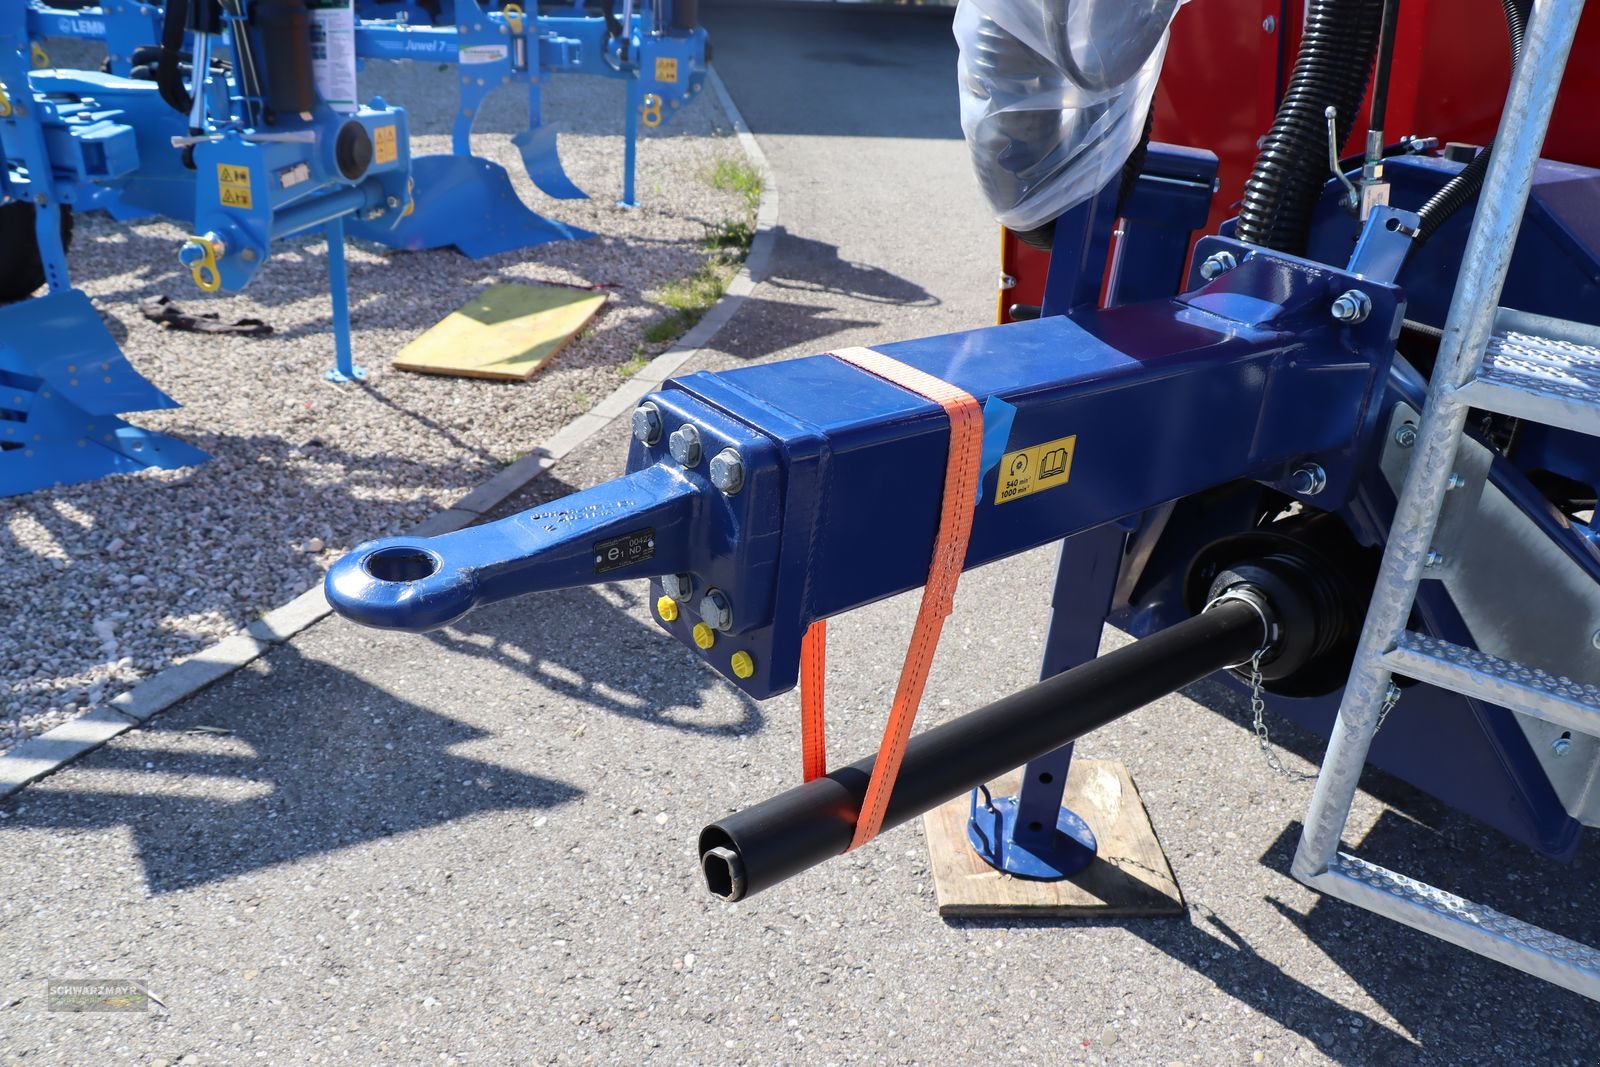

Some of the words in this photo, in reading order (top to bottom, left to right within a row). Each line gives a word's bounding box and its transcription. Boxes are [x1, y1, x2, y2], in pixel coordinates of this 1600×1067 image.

[406, 39, 437, 52] Juwel
[439, 40, 447, 52] 7
[1006, 478, 1018, 489] 540
[1001, 487, 1017, 499] 1000
[629, 545, 642, 555] ND
